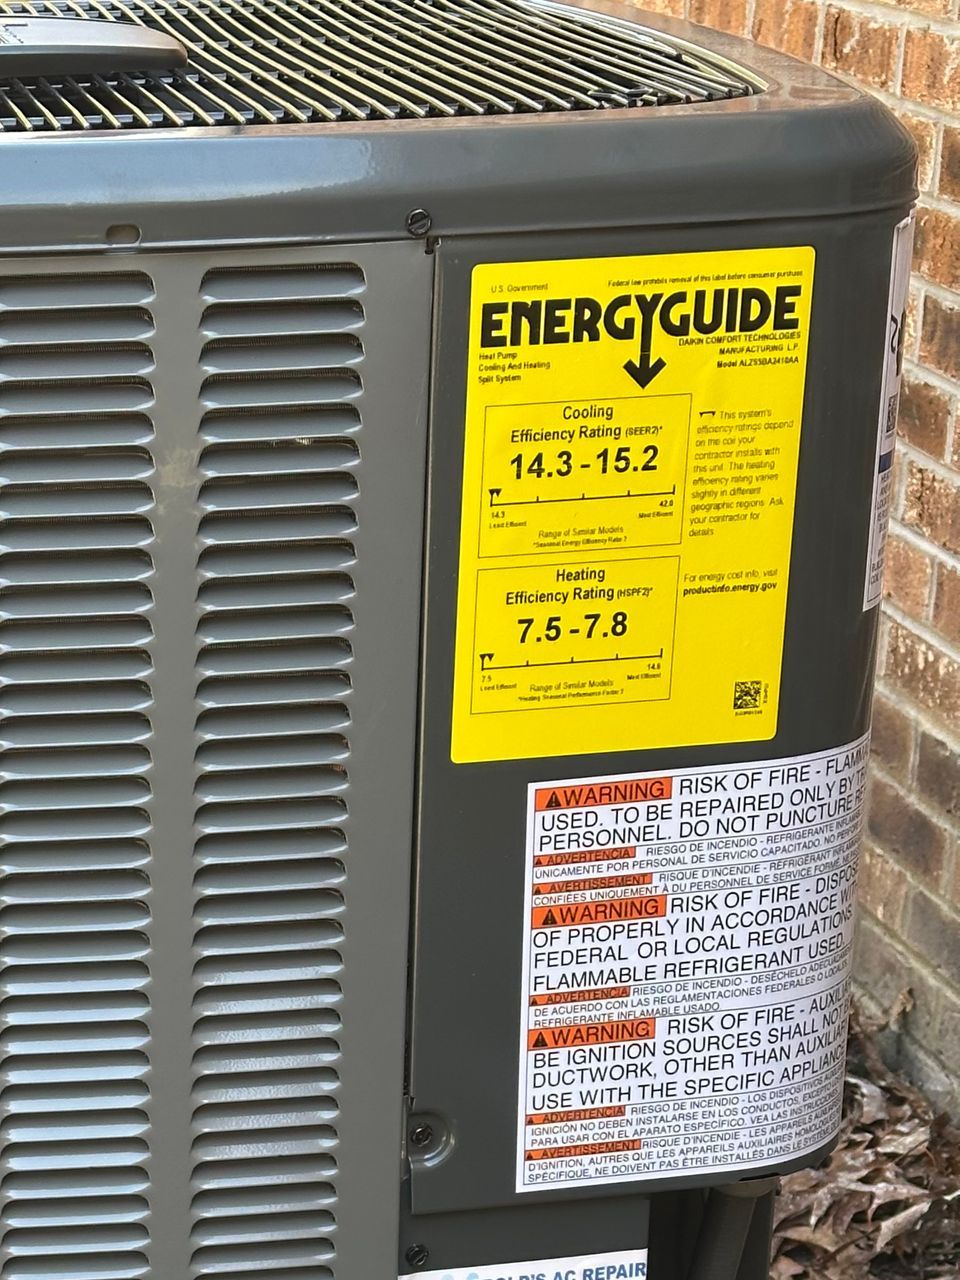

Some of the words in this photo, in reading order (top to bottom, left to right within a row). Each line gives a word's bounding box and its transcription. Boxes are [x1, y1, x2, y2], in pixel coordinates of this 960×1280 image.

[508, 283, 548, 291] Government
[480, 286, 802, 348] ENERGYGUIDE
[679, 338, 704, 346] DAIKIN
[706, 335, 741, 344] COMFORT
[744, 331, 800, 342] TECHNOLOGIES
[479, 352, 495, 360] Heat
[497, 351, 517, 360] Pump
[719, 344, 783, 355] MANUFACTURING
[479, 362, 505, 372] Cooling
[524, 360, 550, 370] Heating
[717, 360, 737, 368] Model
[479, 374, 493, 384] Split
[496, 373, 521, 383] System
[563, 405, 613, 420] Cooling
[511, 427, 575, 443] Efficiency
[579, 424, 621, 441] Rating
[539, 529, 561, 539] Range
[564, 528, 570, 536] of
[572, 527, 595, 536] Similar
[598, 525, 623, 534] Models
[556, 567, 605, 582] Heating
[506, 589, 568, 605] Efficiency
[573, 586, 614, 602] Rating
[684, 582, 777, 596] productinfo.energy.gov
[530, 683, 553, 693] Range
[555, 682, 561, 690] of
[563, 681, 586, 690] Similar
[589, 679, 614, 688] Models
[564, 781, 664, 806] WARNING
[680, 774, 727, 796] RISK
[734, 771, 762, 789] OF
[769, 765, 810, 786] FIRE
[542, 811, 602, 831] USED.
[611, 807, 638, 824] TO
[647, 804, 672, 821] BE
[680, 792, 784, 818] REPAIRED
[791, 781, 836, 806] ONLY
[839, 775, 854, 795] BY
[540, 825, 671, 852] PERSONNEL.
[680, 820, 709, 838] DO
[716, 815, 759, 835] NOT
[766, 793, 852, 830] PUNCTURE
[547, 849, 630, 864] ADVERTENCIA
[646, 844, 686, 856] RIESGO
[690, 843, 705, 852] DE
[707, 838, 757, 850] INCENDIO
[535, 864, 604, 879] ÚNICAMENTE
[607, 862, 630, 871] POR
[632, 858, 687, 870] PERSONAL
[550, 875, 647, 892] AVERTISSEMENT
[560, 899, 658, 923] WARNING
[671, 894, 718, 913] RISK
[725, 891, 753, 908] OF
[759, 884, 800, 905] FIRE
[533, 930, 561, 948] OF
[568, 919, 679, 944] PROPERLY
[686, 917, 704, 933] IN
[711, 894, 837, 931] ACCORDANCE
[535, 945, 628, 968] FEDERAL
[638, 941, 667, 958] OR
[674, 934, 740, 955] LOCAL
[534, 965, 657, 991] FLAMMABLE
[664, 946, 804, 979] REFRIGERANT
[547, 988, 628, 1004] ADVERTENCIA
[534, 1013, 613, 1027] REFRIGERANTE
[617, 1008, 680, 1020] INFLAMABLE
[552, 1021, 649, 1045] WARNING
[668, 1016, 714, 1035] RISK
[721, 1012, 748, 1029] OF
[755, 1005, 795, 1026] FIRE
[534, 1052, 559, 1068] BE
[567, 1042, 656, 1065] IGNITION
[663, 1030, 761, 1056] SOURCES
[768, 1021, 818, 1044] SHALL
[822, 1003, 842, 1029] NOT
[533, 1063, 656, 1088] DUCTWORK,
[664, 1054, 734, 1075] OTHER
[741, 1046, 791, 1068] THAN
[532, 1092, 572, 1110] USE
[580, 1086, 631, 1105] WITH
[638, 1081, 677, 1099] THE
[684, 1071, 774, 1096] SPECIFIC
[543, 1107, 624, 1122] ADVERTENCIA
[542, 1141, 636, 1159] AVERTISSEMENT
